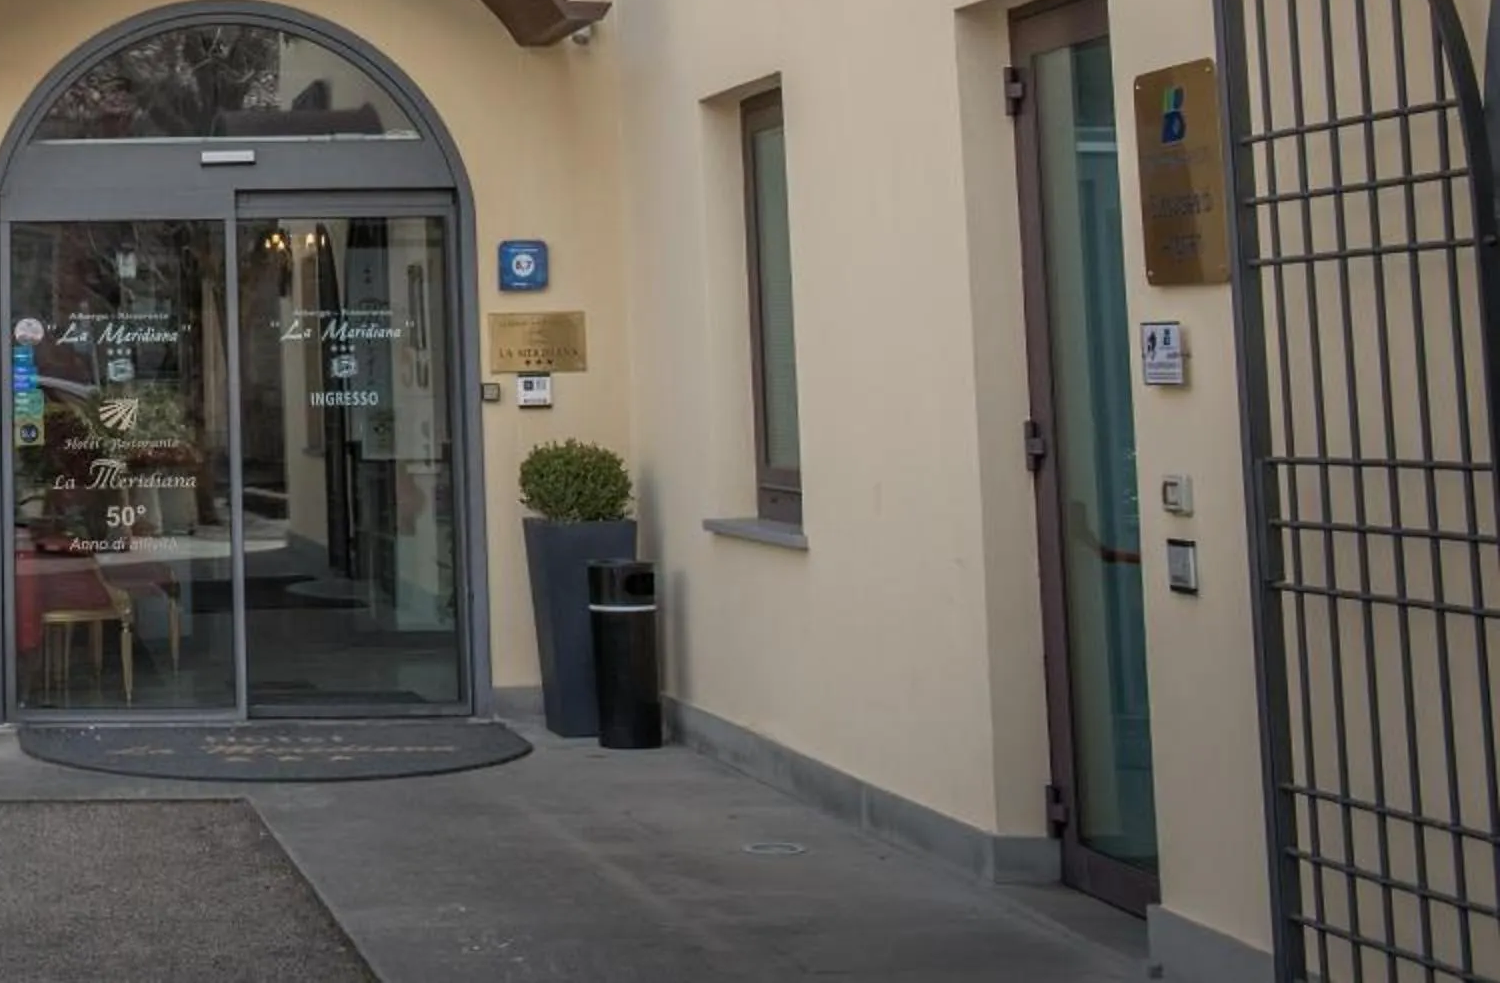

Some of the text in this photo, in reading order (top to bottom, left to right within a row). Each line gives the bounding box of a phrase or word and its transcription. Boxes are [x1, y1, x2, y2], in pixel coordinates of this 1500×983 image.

[311, 392, 380, 407] INGRESSO
[52, 458, 197, 490] La Meridiana
[105, 504, 148, 528] 50°
[68, 537, 109, 551] Anno
[113, 536, 126, 550] di
